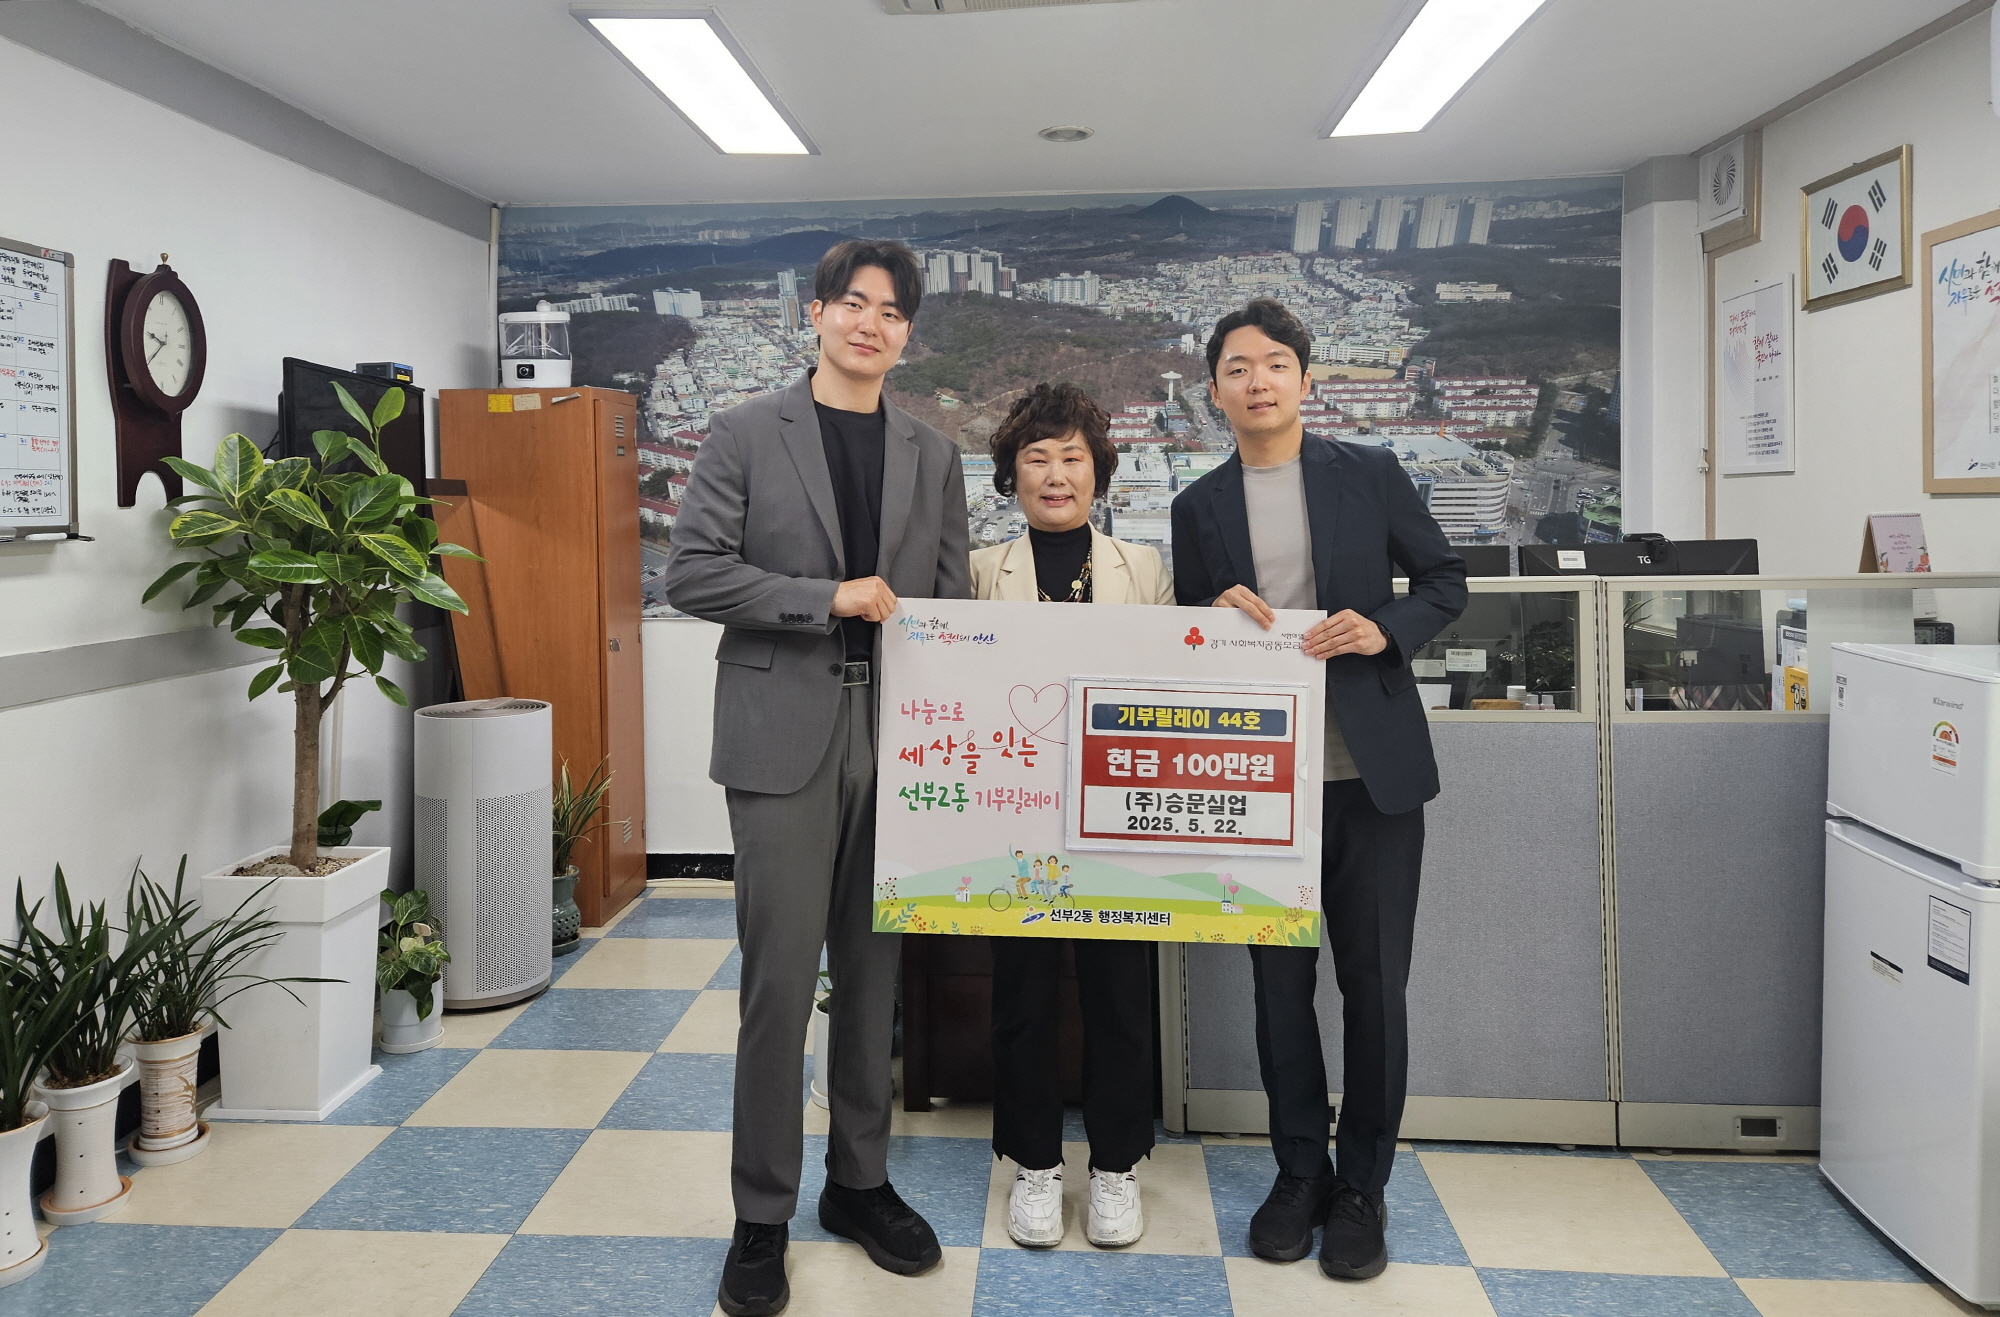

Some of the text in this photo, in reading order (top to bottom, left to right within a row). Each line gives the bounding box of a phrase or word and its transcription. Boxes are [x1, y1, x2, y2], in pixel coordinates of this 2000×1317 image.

[1637, 555, 1652, 564] TG
[898, 614, 927, 632] 시민과
[938, 632, 970, 646] 혁신도시
[972, 633, 999, 645] 안산
[1229, 640, 1303, 651] 사회복지공동모금
[900, 698, 965, 725] 나눔으로
[1117, 706, 1261, 730] 기부릴레이 44호
[899, 726, 1038, 775] 세상을 잇는
[1106, 748, 1274, 782] 현금 100만원
[899, 781, 1060, 815] 선부2동 기부릴레이
[1125, 791, 1247, 816] (주)승문실업
[1127, 815, 1243, 836] 2025. 5. 22.
[1050, 908, 1171, 926] 선부2동 행정복지센터
